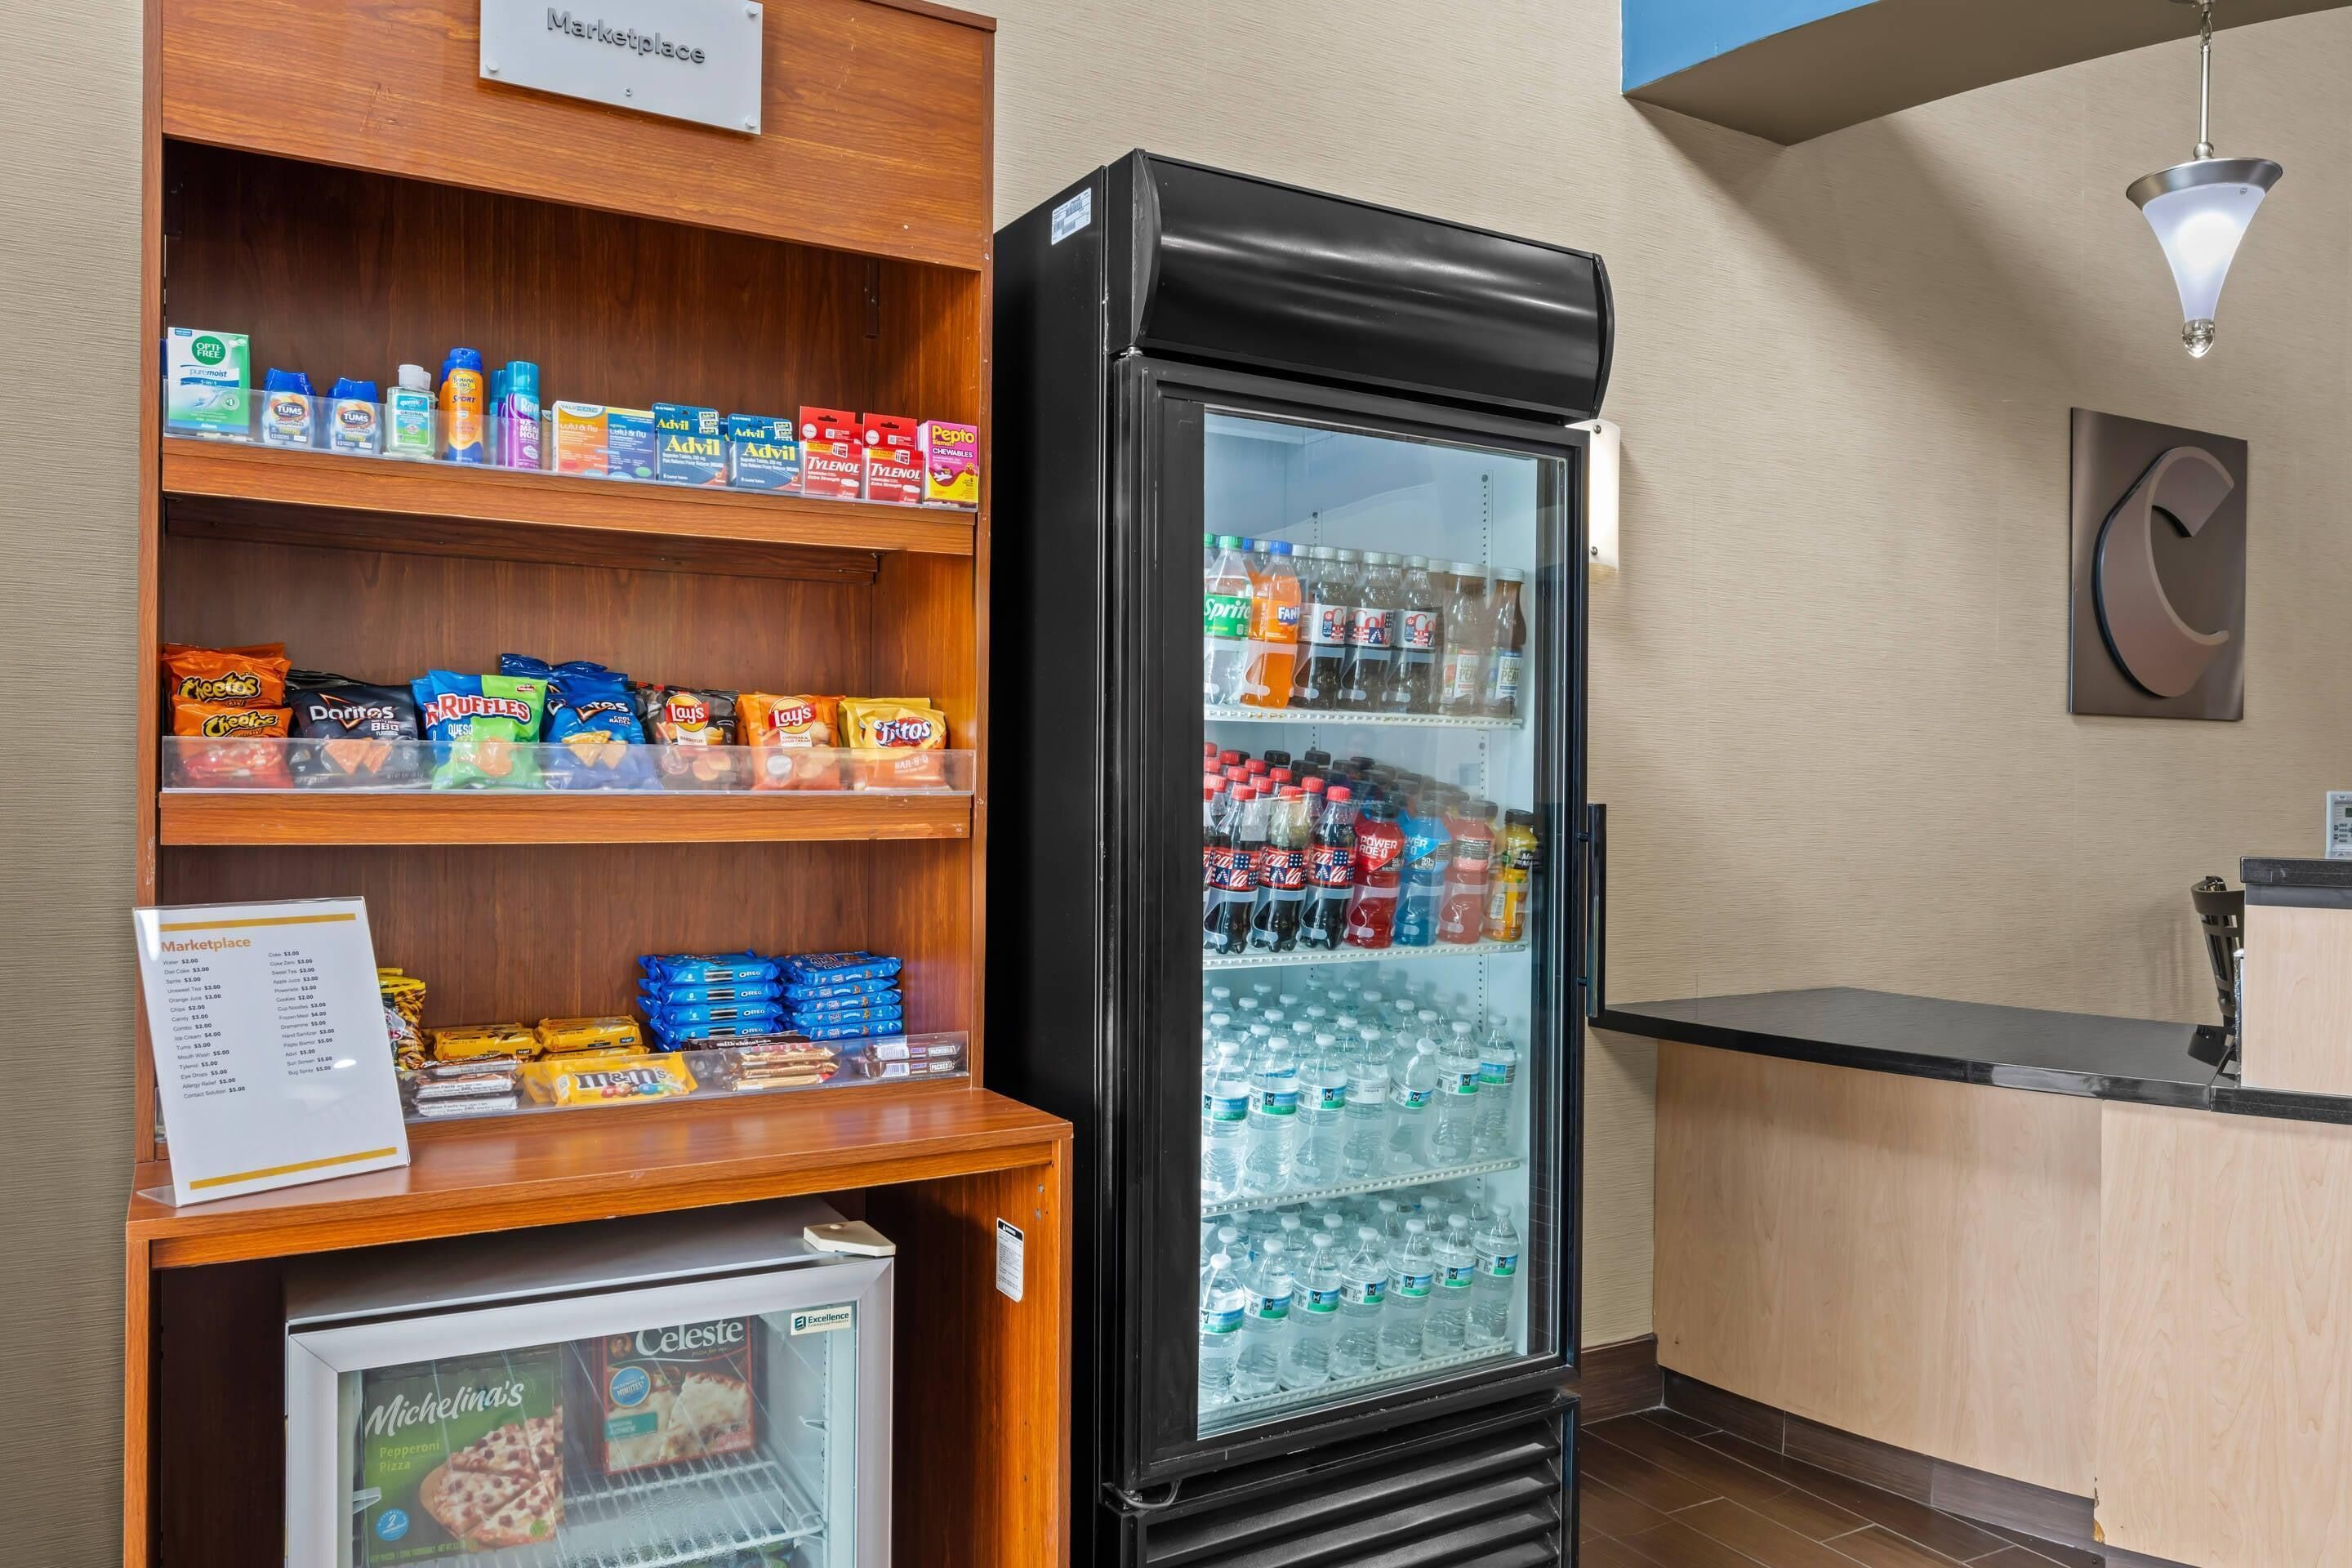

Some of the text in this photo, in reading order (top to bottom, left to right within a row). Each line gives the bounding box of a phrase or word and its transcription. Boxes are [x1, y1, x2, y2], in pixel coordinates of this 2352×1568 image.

[546, 7, 706, 64] Marketplace
[196, 342, 222, 352] OPTI-
[197, 350, 220, 359] FREE
[189, 368, 228, 378] puremoist
[452, 394, 477, 403] SPORT
[278, 405, 303, 415] TUMS
[343, 412, 368, 423] TUMS
[656, 418, 689, 431] Advil
[735, 428, 765, 439] Advil
[932, 425, 975, 444] Pepto
[664, 435, 720, 457] Advil
[742, 442, 795, 461] Advil
[932, 448, 973, 458] CHEWABLES
[807, 456, 861, 474] TYLENOL
[871, 463, 921, 480] TYLENOL
[1204, 598, 1251, 621] Sprite
[179, 672, 259, 701] Cheetos
[309, 705, 394, 722] Doritos
[438, 693, 531, 723] RUFFLES
[670, 702, 706, 724] Lay's
[773, 705, 812, 728] Lay's
[203, 710, 278, 737] Cheetos
[448, 724, 473, 737] QUESO
[873, 719, 933, 745] Fritos
[1360, 835, 1398, 849] POWER
[160, 937, 252, 952] Marketplace
[738, 970, 761, 978] OREO
[743, 1009, 765, 1017] OREO
[742, 1027, 764, 1035] OREO
[574, 1067, 668, 1089] m&m's
[808, 1312, 849, 1324] Excellence
[635, 1318, 744, 1356] Celeste
[365, 1380, 525, 1438] Michelina's
[379, 1439, 441, 1459] Pepperoni
[379, 1460, 411, 1473] Pizza
